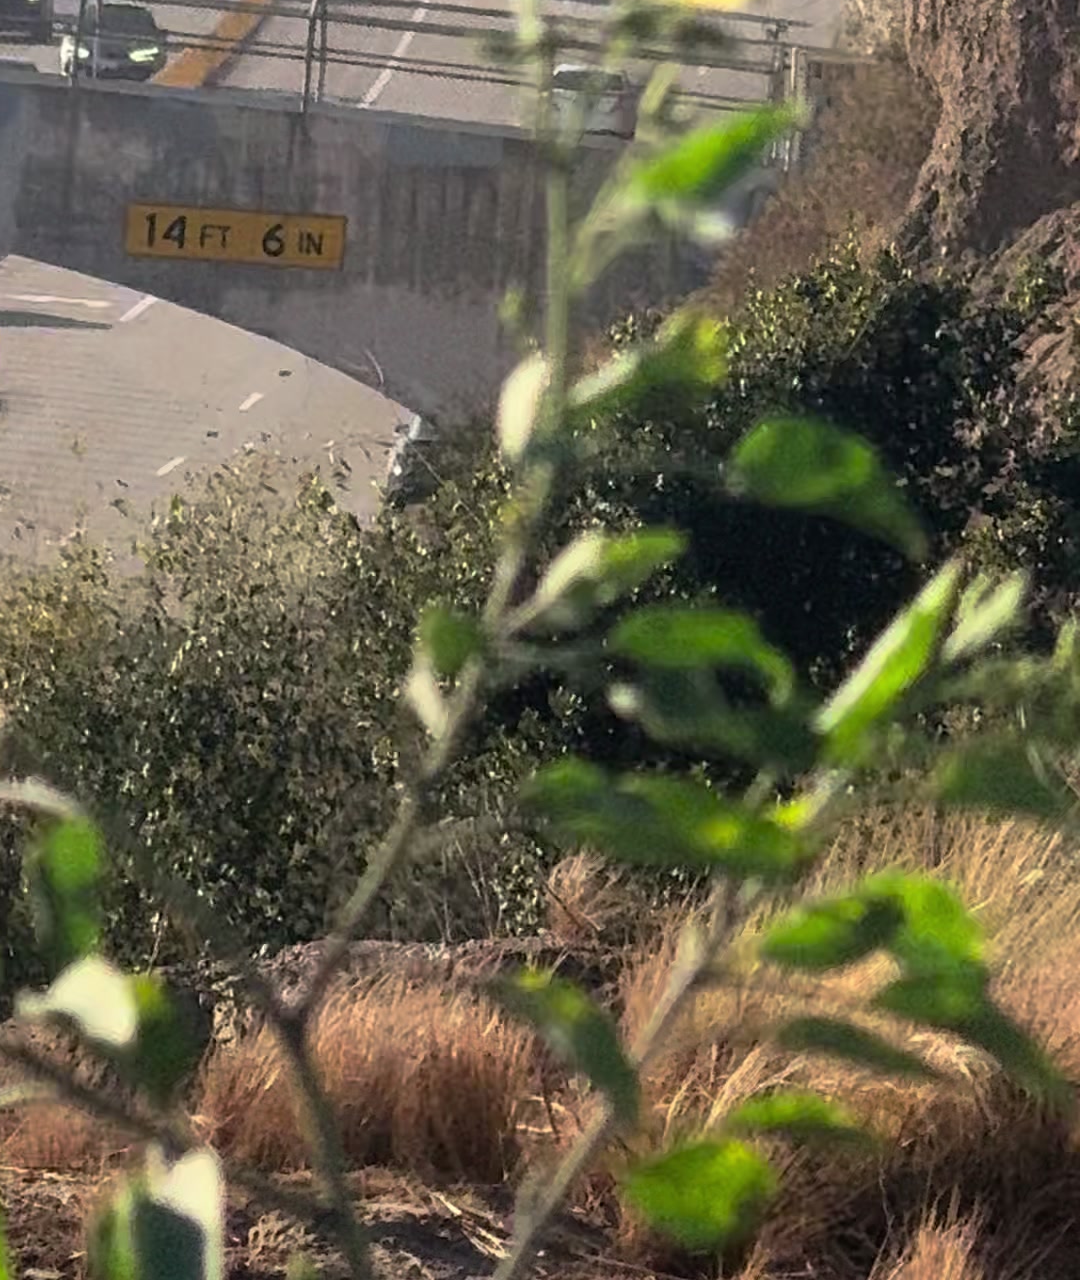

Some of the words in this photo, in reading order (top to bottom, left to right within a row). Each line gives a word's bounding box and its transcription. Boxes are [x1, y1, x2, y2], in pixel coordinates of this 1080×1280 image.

[145, 212, 187, 249] 14
[199, 224, 231, 249] FT
[262, 223, 285, 258] 6
[298, 230, 324, 256] IN
